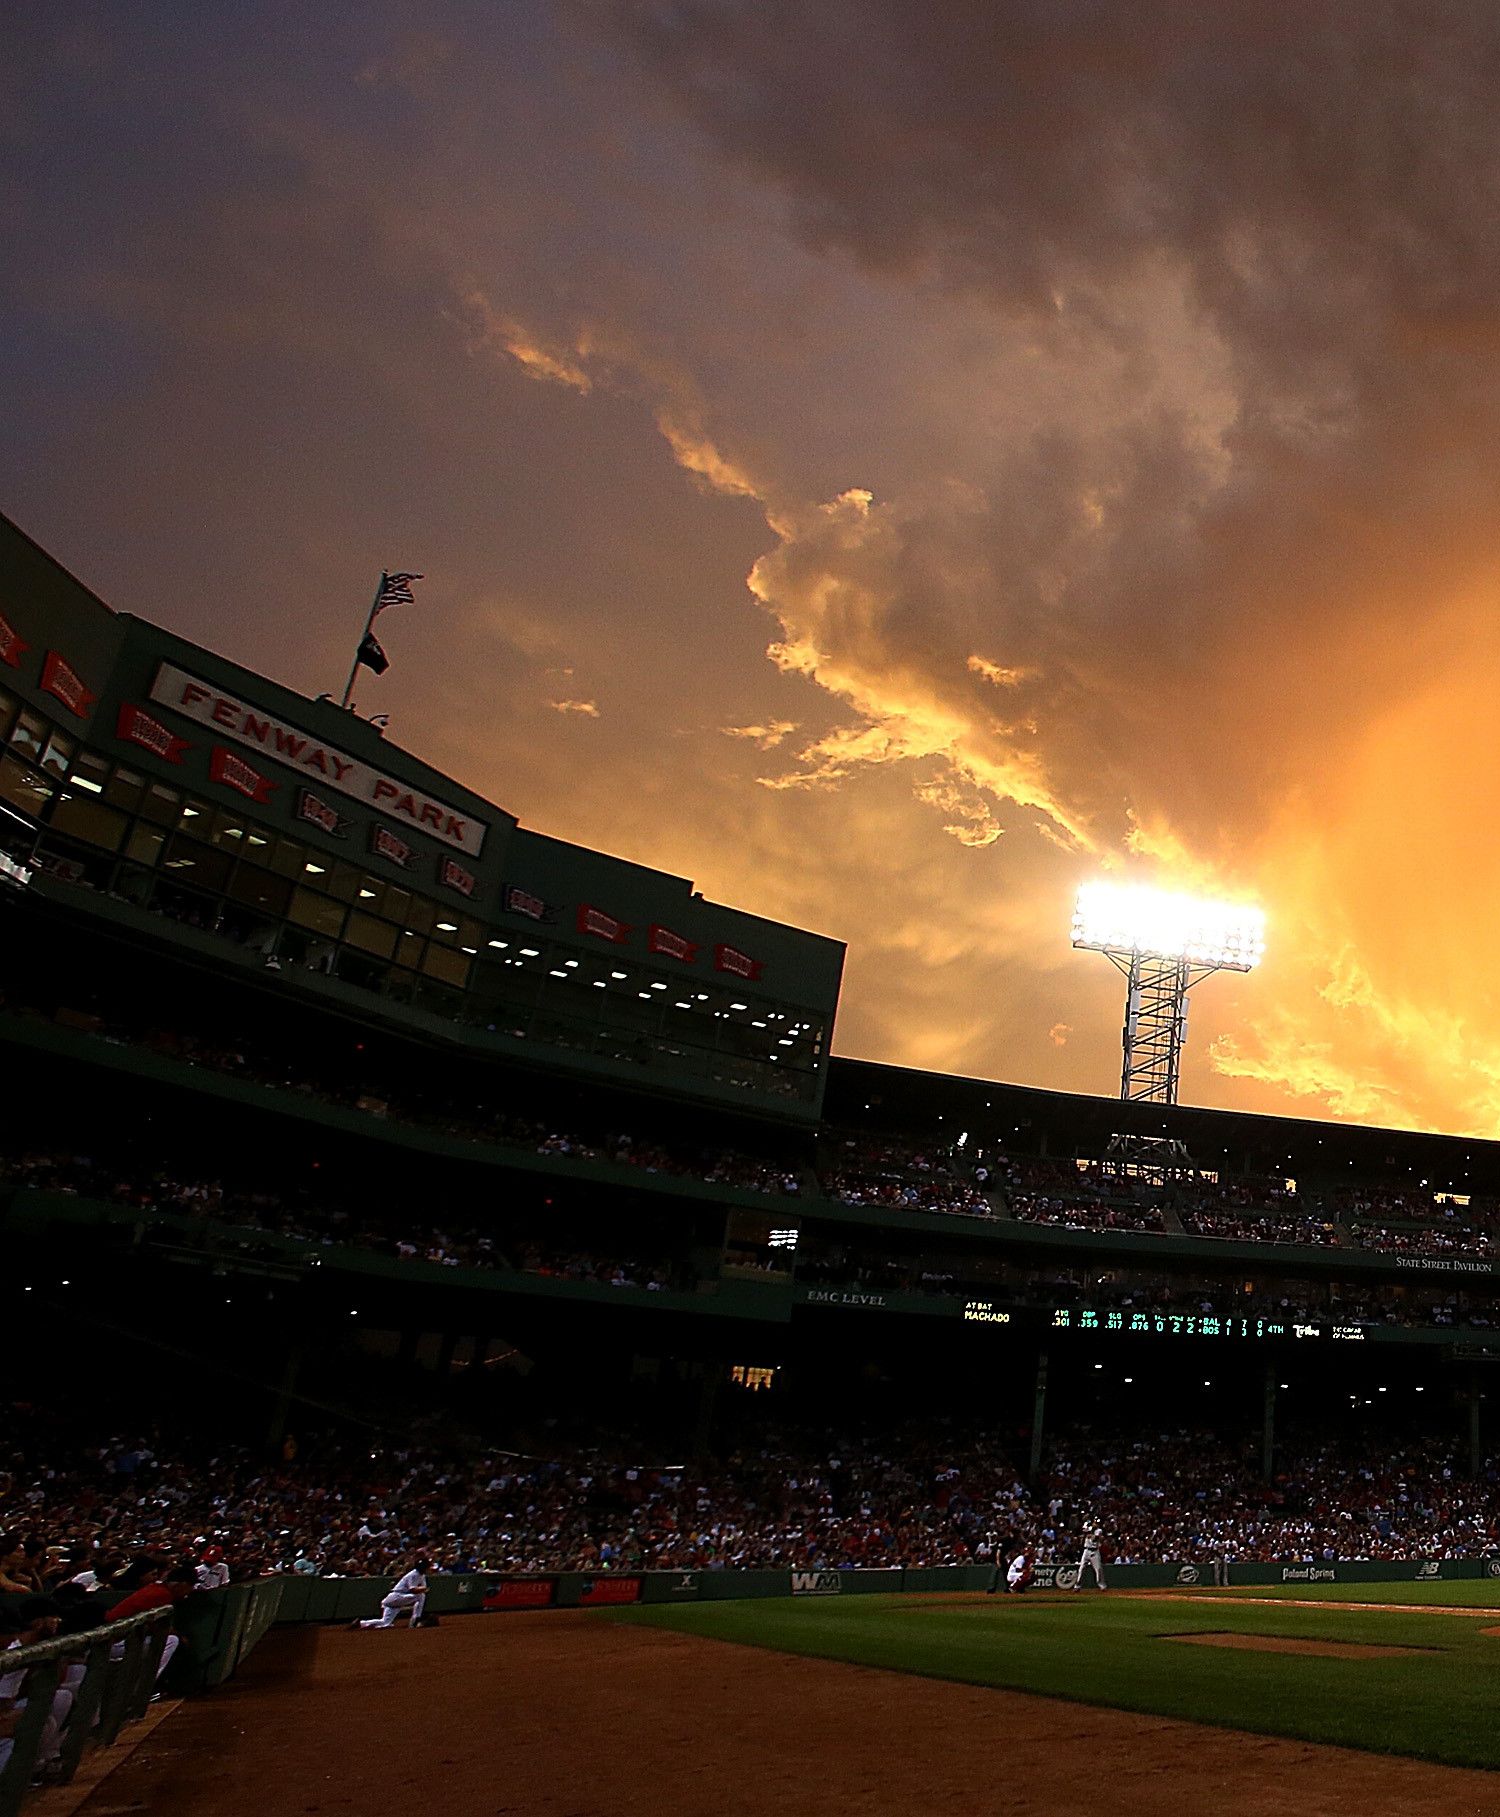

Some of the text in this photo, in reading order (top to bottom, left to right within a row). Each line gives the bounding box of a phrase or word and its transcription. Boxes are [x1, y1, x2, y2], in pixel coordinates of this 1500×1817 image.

[180, 682, 353, 780] FENWAY
[372, 779, 466, 841] PARK
[807, 1290, 888, 1307] EMC LEVEL
[965, 1302, 993, 1311] AT BAT
[964, 1310, 1010, 1323] MACHADO
[1202, 1317, 1221, 1327] BAL
[1225, 1318, 1232, 1327] 4
[1241, 1319, 1248, 1328] 7
[1256, 1320, 1263, 1329] 0
[1051, 1316, 1070, 1327] .301
[1077, 1318, 1099, 1328] .359
[1104, 1319, 1123, 1329] .517
[1156, 1321, 1164, 1332] 0
[1172, 1321, 1180, 1333] 2
[1186, 1322, 1195, 1334] 2
[1202, 1325, 1263, 1338] BOS 1 3 0
[1267, 1325, 1284, 1335] 4TH
[1283, 1567, 1335, 1580] Poland Spring
